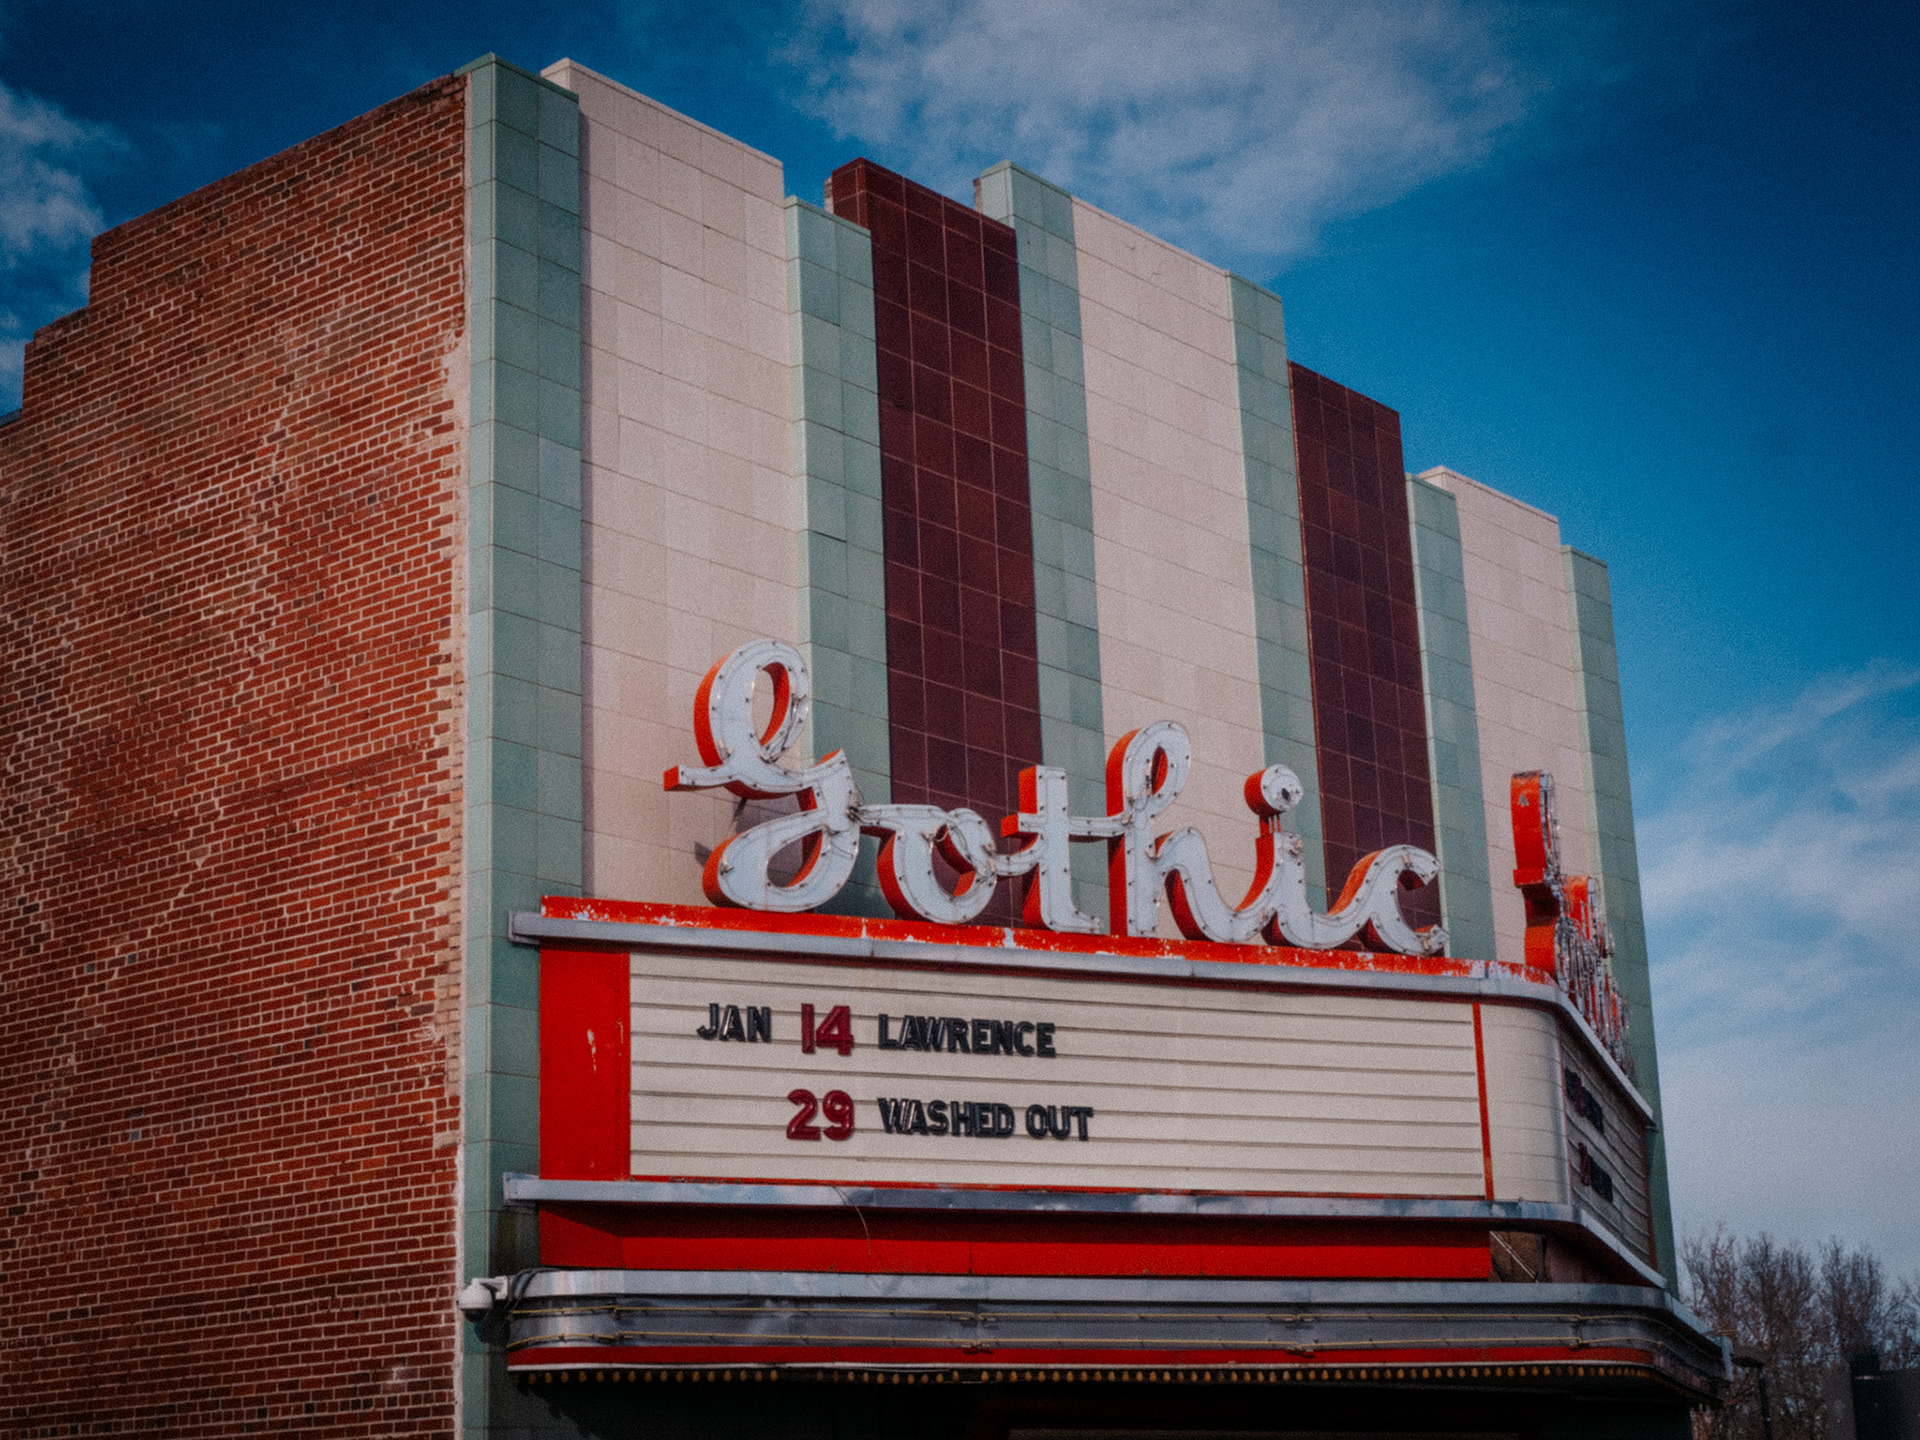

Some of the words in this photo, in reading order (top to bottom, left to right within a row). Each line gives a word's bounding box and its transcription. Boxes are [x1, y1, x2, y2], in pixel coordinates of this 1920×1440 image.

[696, 1003, 771, 1042] JAN
[801, 1003, 854, 1056] 14
[878, 1013, 1057, 1058] LAWRENCE
[786, 1089, 855, 1141] 29
[877, 1098, 1015, 1139] WASHED
[1025, 1104, 1094, 1141] OUT
